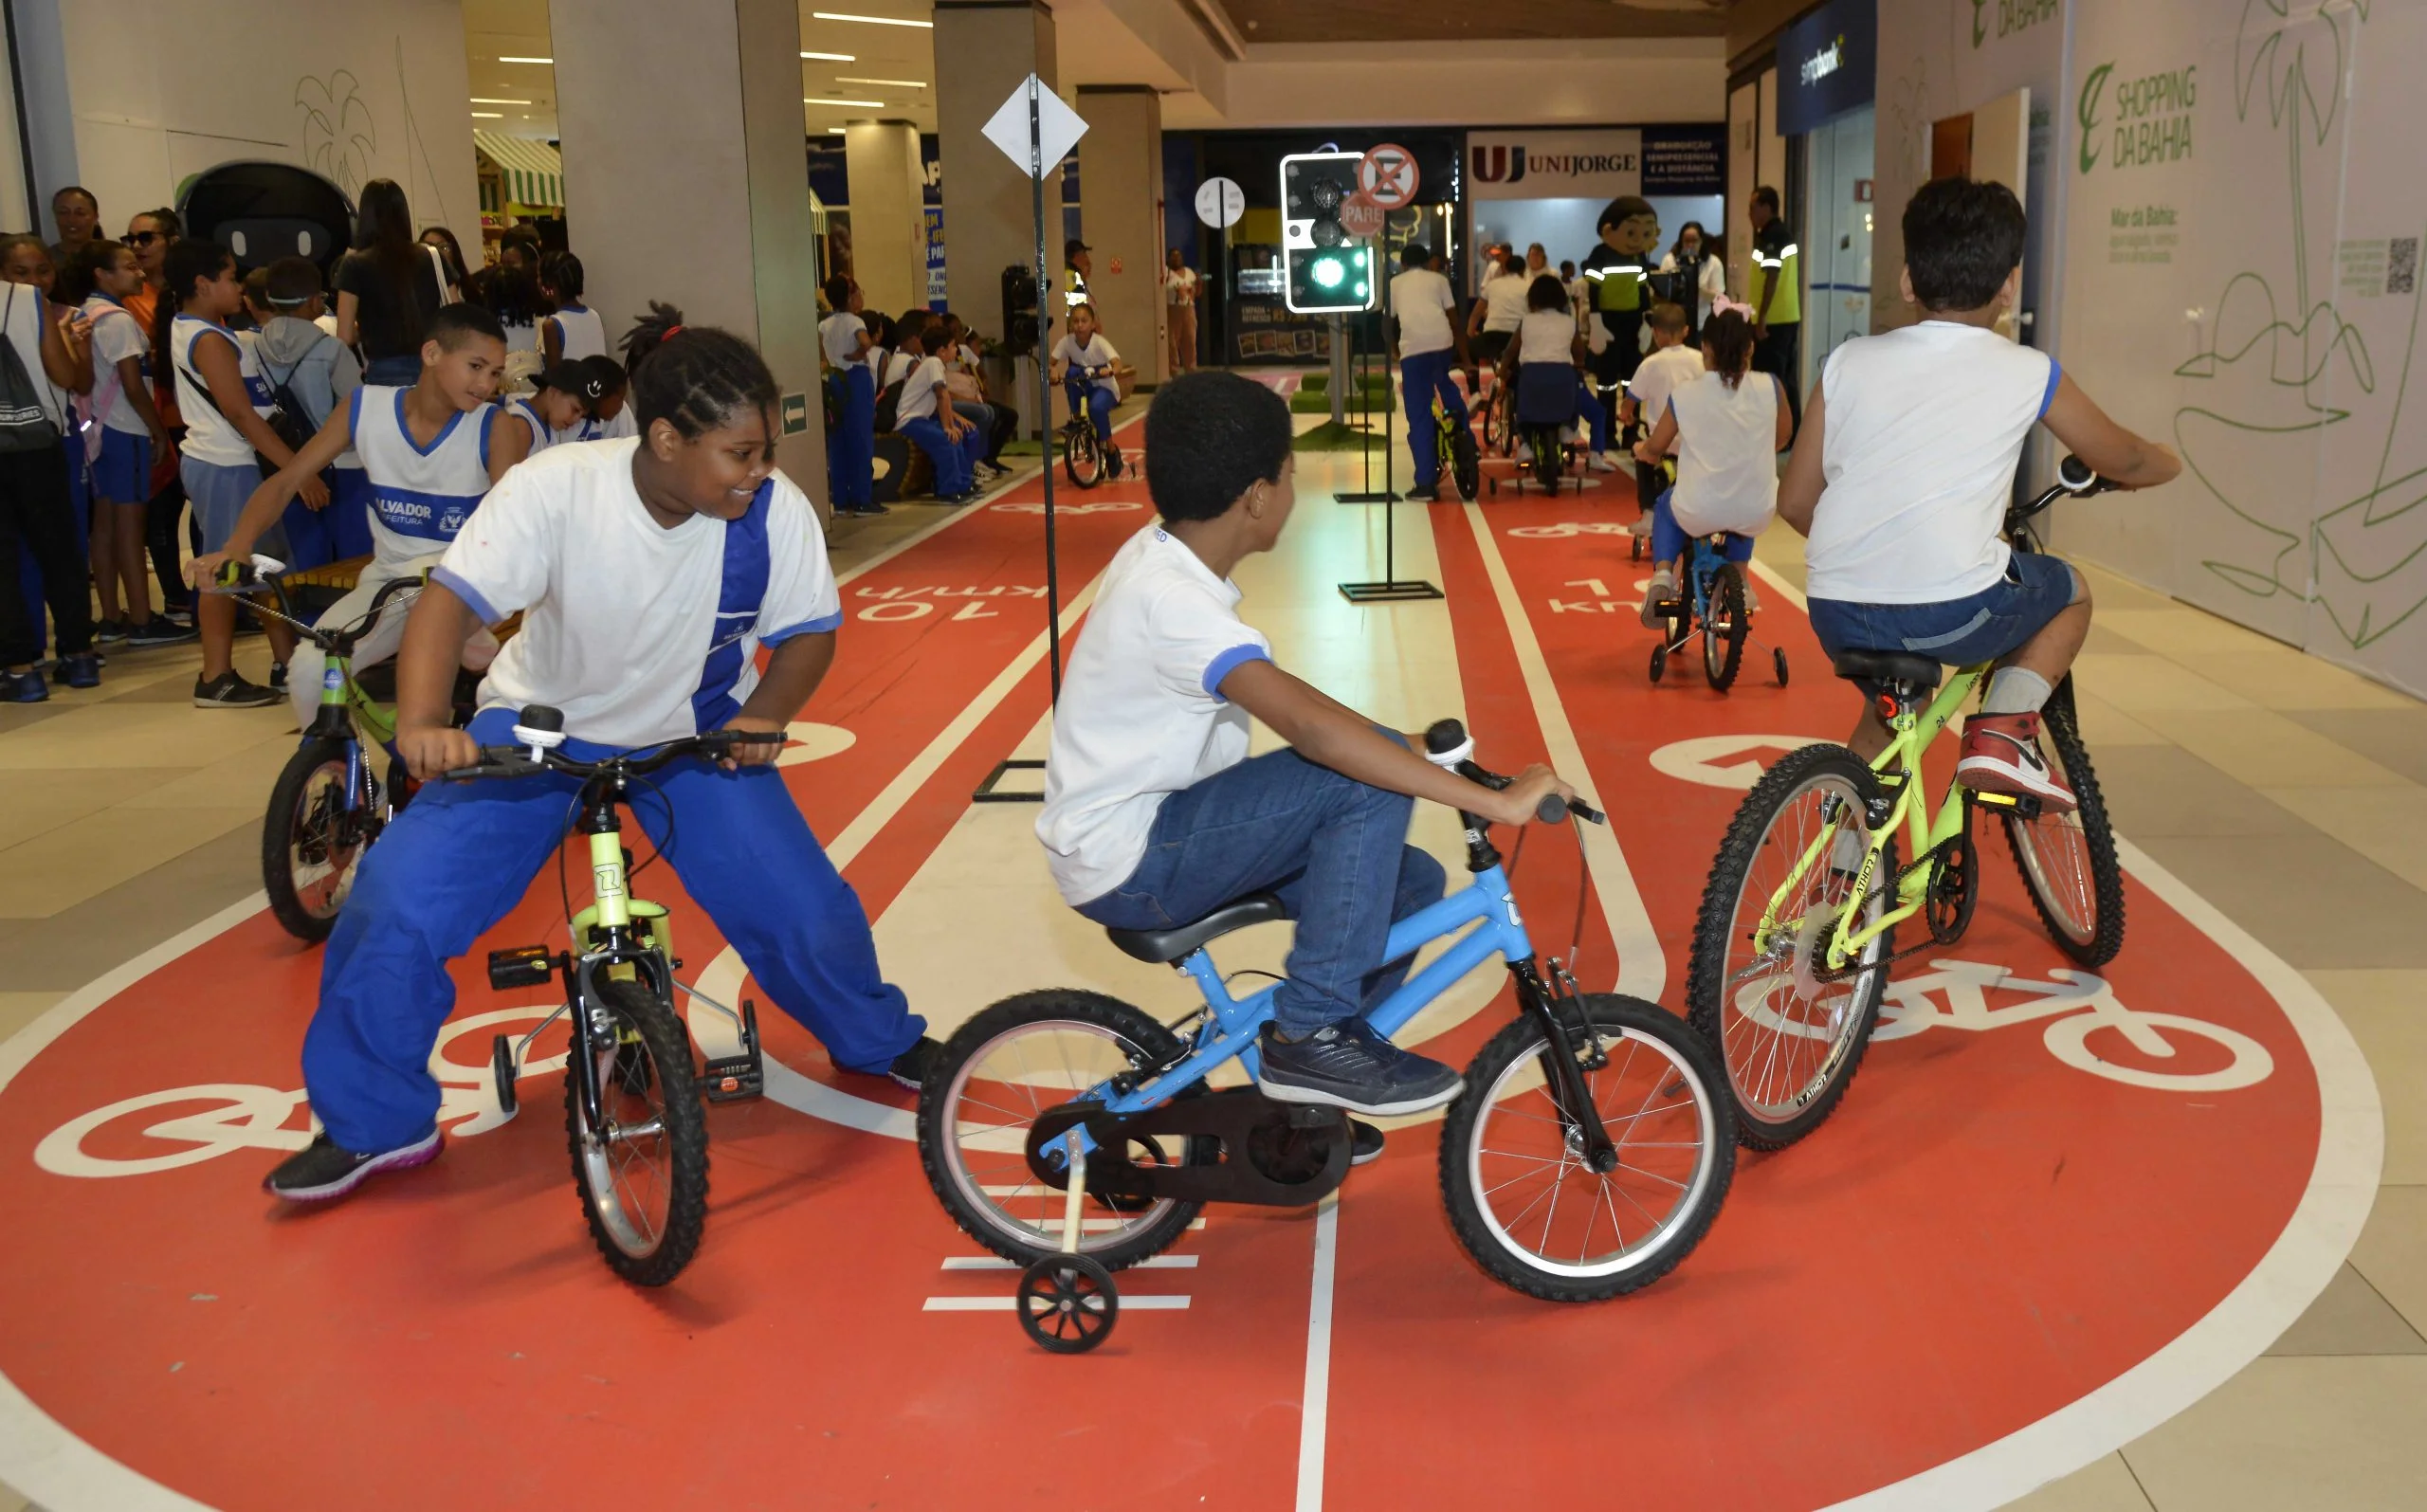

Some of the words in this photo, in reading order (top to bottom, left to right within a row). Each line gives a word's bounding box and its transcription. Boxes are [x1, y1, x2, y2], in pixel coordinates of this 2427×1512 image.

[2116, 64, 2197, 121] SHOPPING
[2113, 126, 2136, 170] DA
[2138, 115, 2192, 166] BAHIA
[1529, 155, 1637, 178] UNIJORGE
[1346, 206, 1382, 224] PARE
